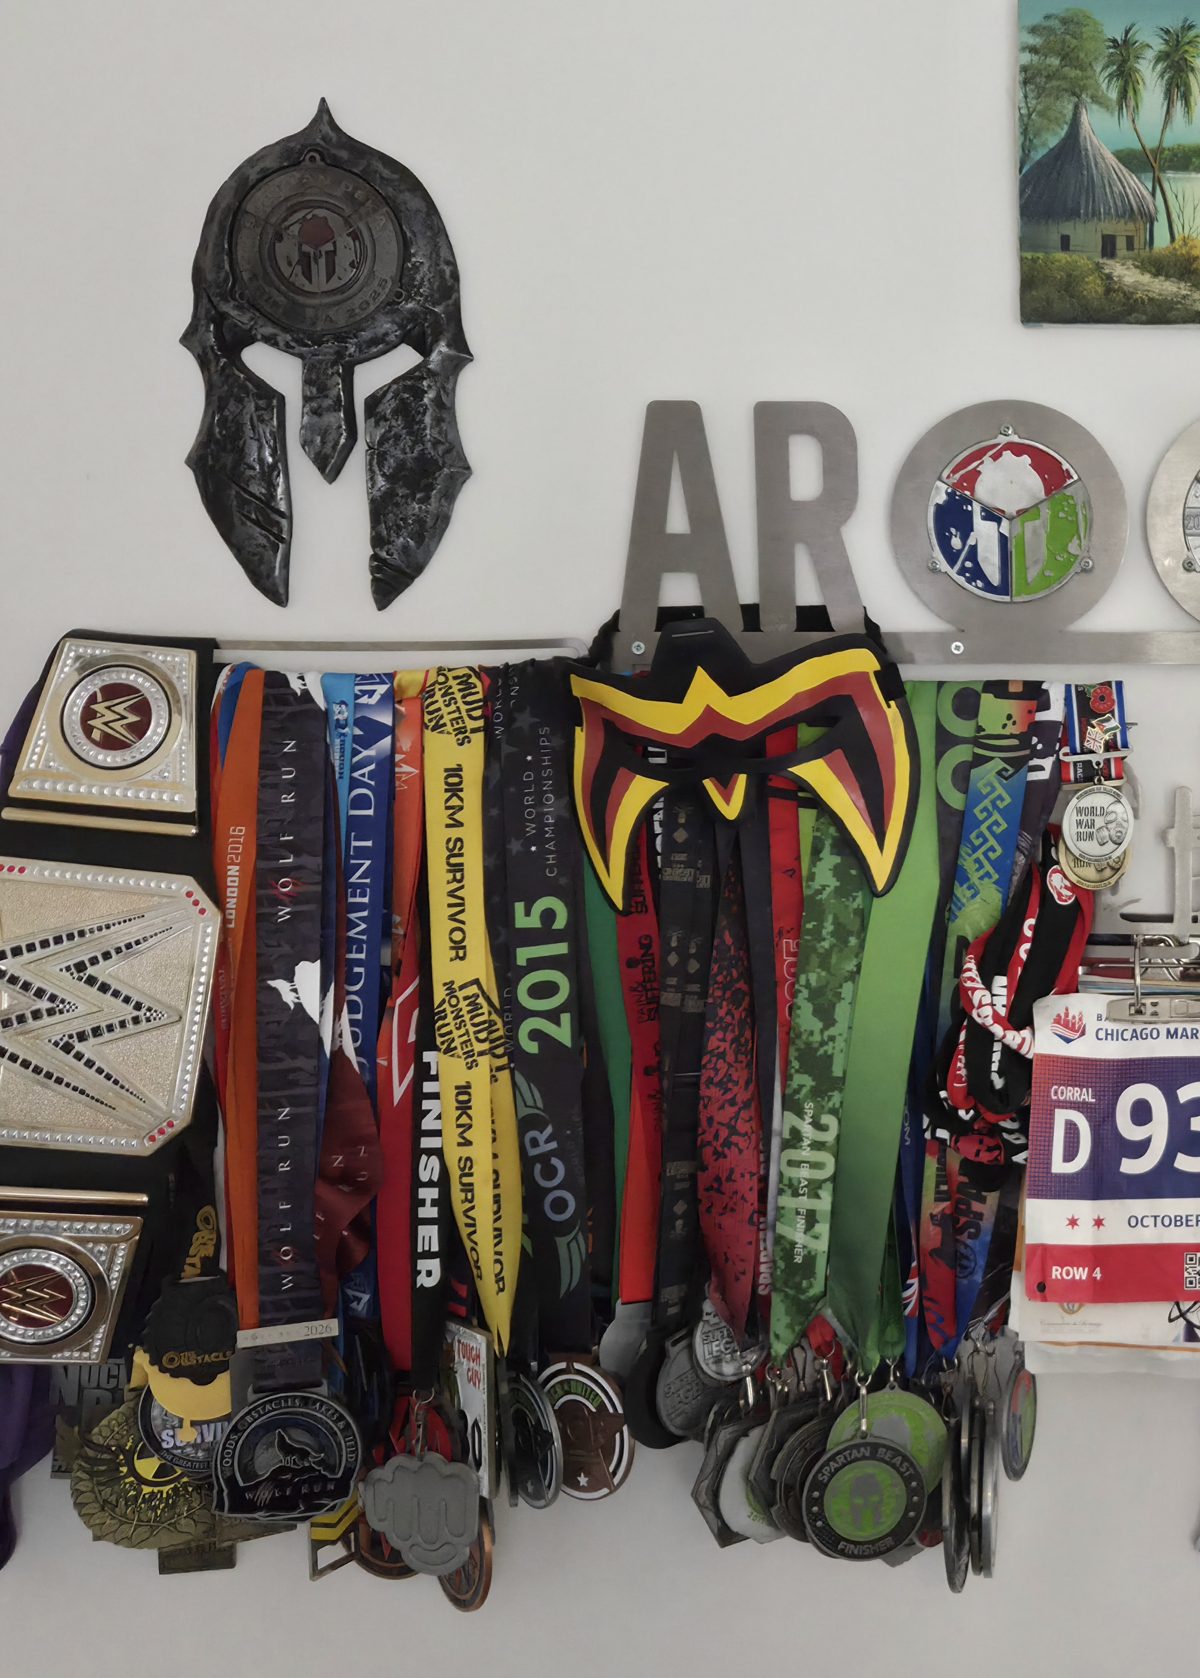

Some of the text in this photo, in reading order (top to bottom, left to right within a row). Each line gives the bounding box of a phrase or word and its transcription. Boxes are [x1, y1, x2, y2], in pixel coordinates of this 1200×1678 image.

[452, 672, 485, 721] MUD
[347, 749, 376, 817] DAY
[522, 770, 537, 837] WORLD
[538, 726, 558, 877] CHAMPIONSHIPS
[1075, 805, 1106, 818] WORLD
[278, 740, 297, 924] WOLF RUN
[1075, 818, 1096, 830] WAR
[1075, 830, 1095, 843] RUN
[225, 825, 247, 930] LONDON 2016
[443, 764, 468, 962] 10KM SURVIVOR
[514, 895, 574, 1055] 2015
[638, 934, 660, 1022] SUFFERING
[442, 980, 480, 1071] MONSTERS
[1094, 1026, 1161, 1042] CHICAGO
[1050, 1084, 1096, 1103] CORRAL
[799, 1101, 814, 1157] SPARTAN
[1050, 1108, 1093, 1175] D
[277, 1106, 293, 1291] WOLF RUN
[415, 1050, 443, 1289] FINISHER
[453, 1081, 483, 1280] 10KM SURVIVOR
[523, 1124, 577, 1223] OCR
[776, 1108, 841, 1257] 2017
[797, 1162, 811, 1205] BEAST
[1051, 1265, 1103, 1281] ROW 4
[303, 1322, 333, 1337] 2026
[456, 1338, 481, 1367] TOUGH
[466, 1366, 482, 1390] GUY
[817, 1445, 915, 1483] SPARTAN BEAST
[837, 1535, 895, 1556] FINISHER
